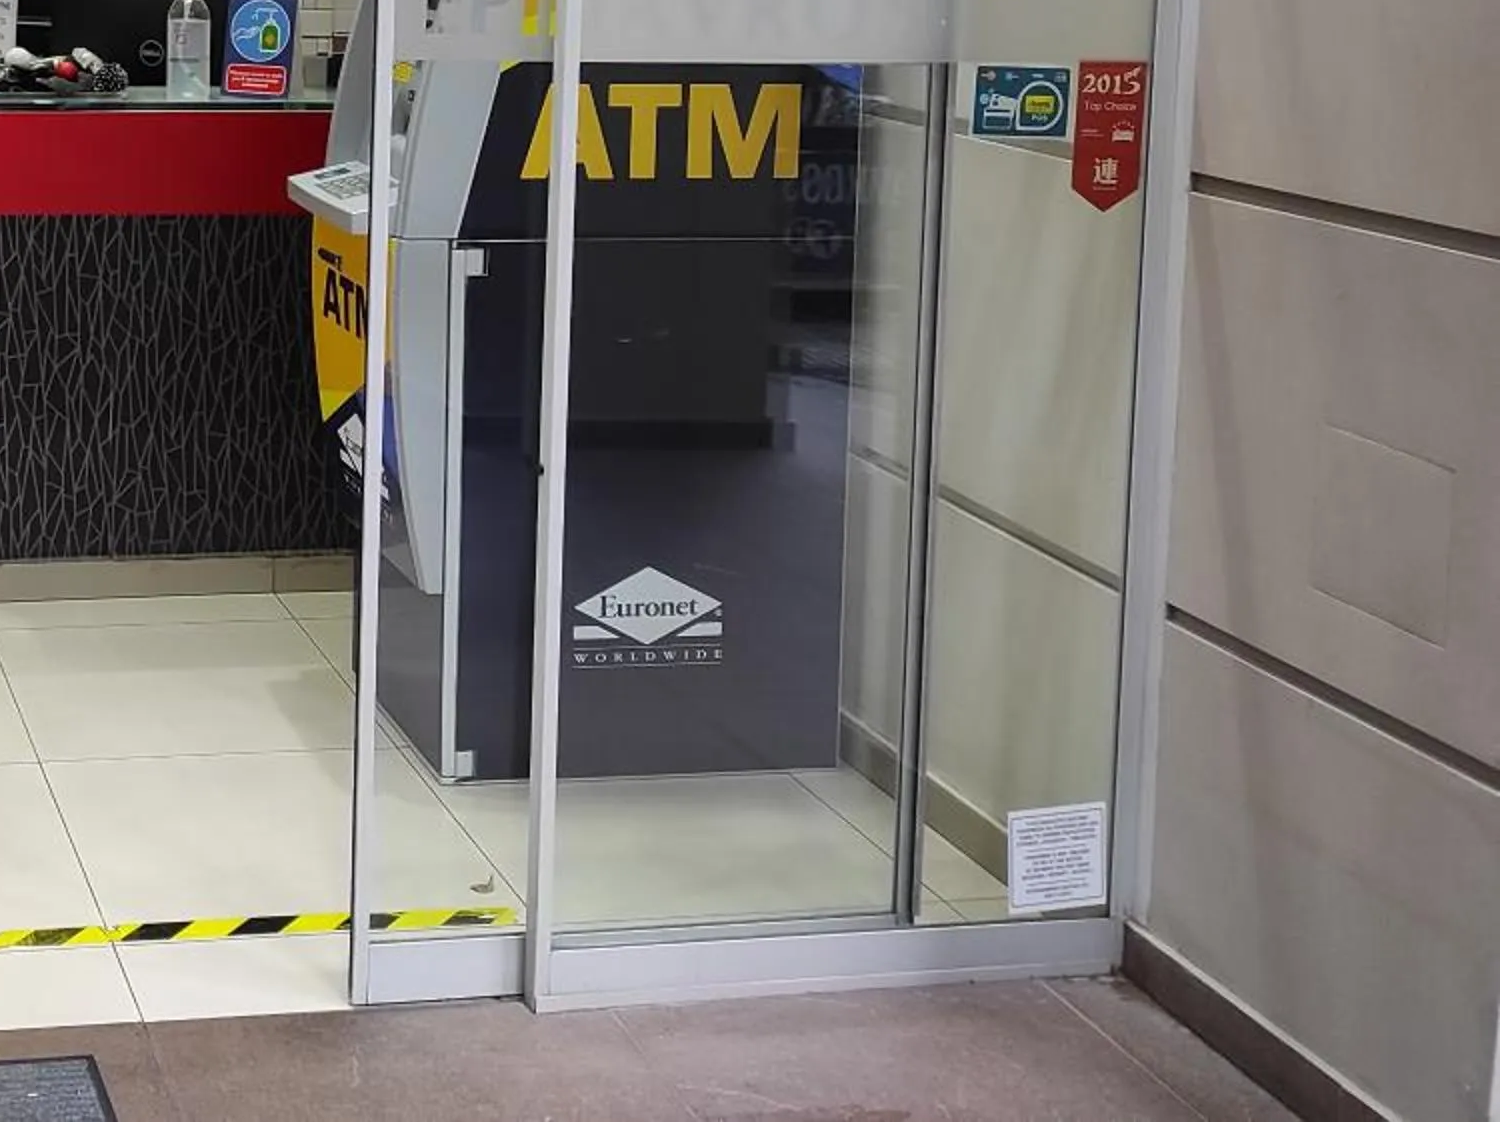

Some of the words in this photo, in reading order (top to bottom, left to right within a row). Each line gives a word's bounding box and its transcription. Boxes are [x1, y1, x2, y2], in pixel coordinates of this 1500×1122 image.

[1082, 66, 1141, 95] 2015
[1084, 100, 1102, 113] Top
[520, 83, 803, 180] ATM
[600, 595, 699, 618] Euronet
[573, 649, 723, 663] WORLDWIDE
